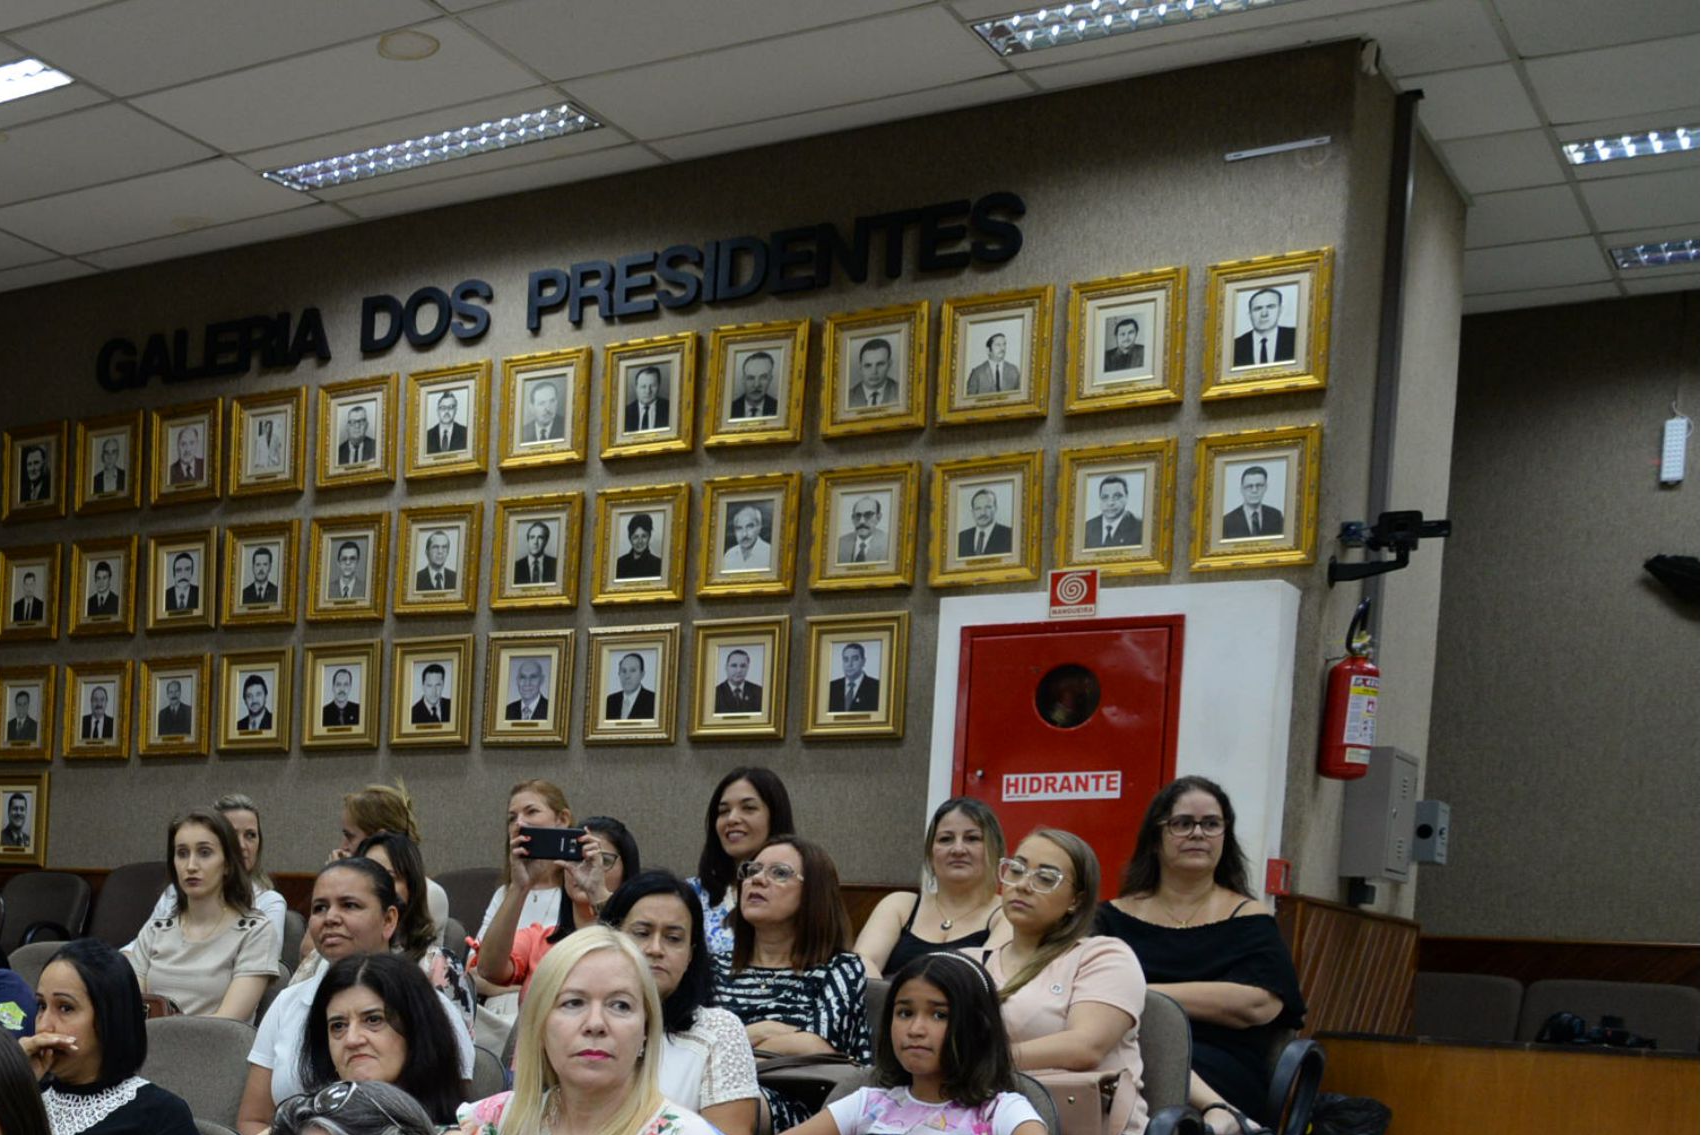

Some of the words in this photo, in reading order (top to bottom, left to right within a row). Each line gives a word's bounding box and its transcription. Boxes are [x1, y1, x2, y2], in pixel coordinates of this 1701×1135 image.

[97, 306, 332, 392] GALERIA
[360, 278, 494, 354] DOS
[527, 191, 1026, 332] PRESIDENTES
[1005, 773, 1119, 795] HIDRANTE
